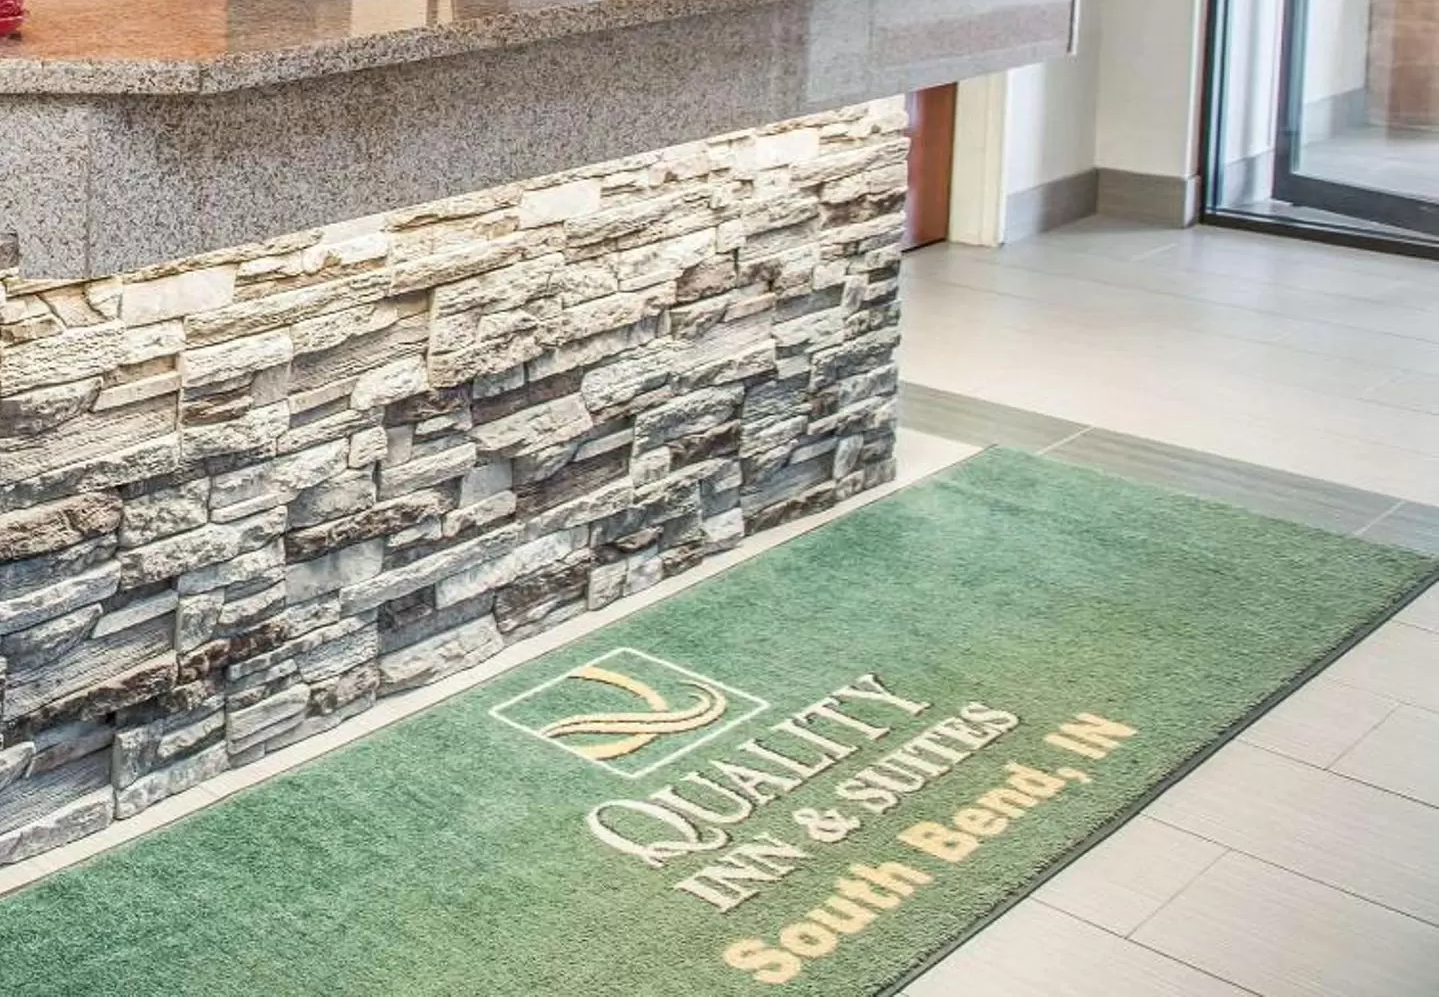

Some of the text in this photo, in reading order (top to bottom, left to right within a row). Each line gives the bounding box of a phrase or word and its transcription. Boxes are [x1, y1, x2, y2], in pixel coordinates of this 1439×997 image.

[586, 672, 930, 867] QUALITY
[674, 700, 1023, 913] INN & SUITES
[723, 856, 934, 985] South
